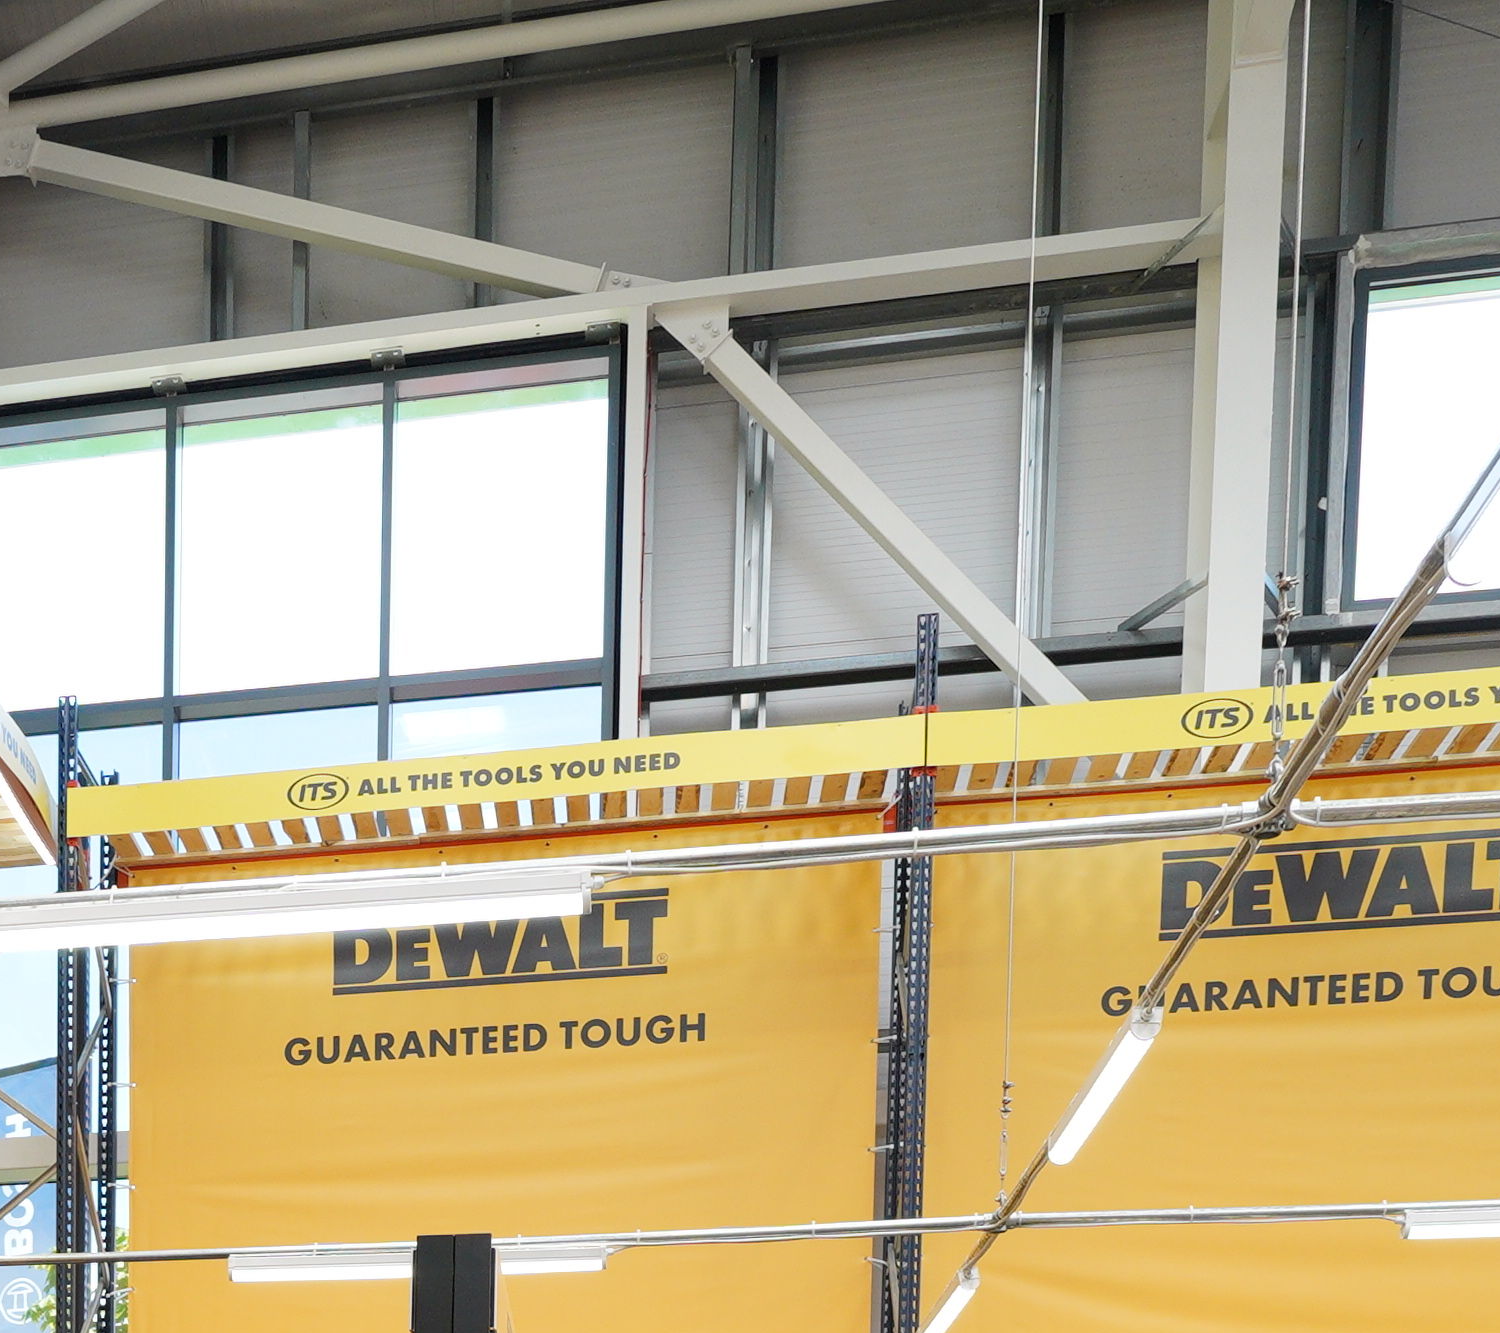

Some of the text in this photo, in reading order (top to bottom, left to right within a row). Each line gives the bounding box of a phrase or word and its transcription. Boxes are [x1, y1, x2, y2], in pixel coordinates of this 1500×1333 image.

[1195, 707, 1241, 731] ITS
[1264, 701, 1316, 725] ALL
[1383, 687, 1480, 714] TOOLS
[297, 752, 681, 804] ITS ALL THE TOOLS YOU NEED
[285, 1012, 708, 1067] GUARANTEED TOUGH
